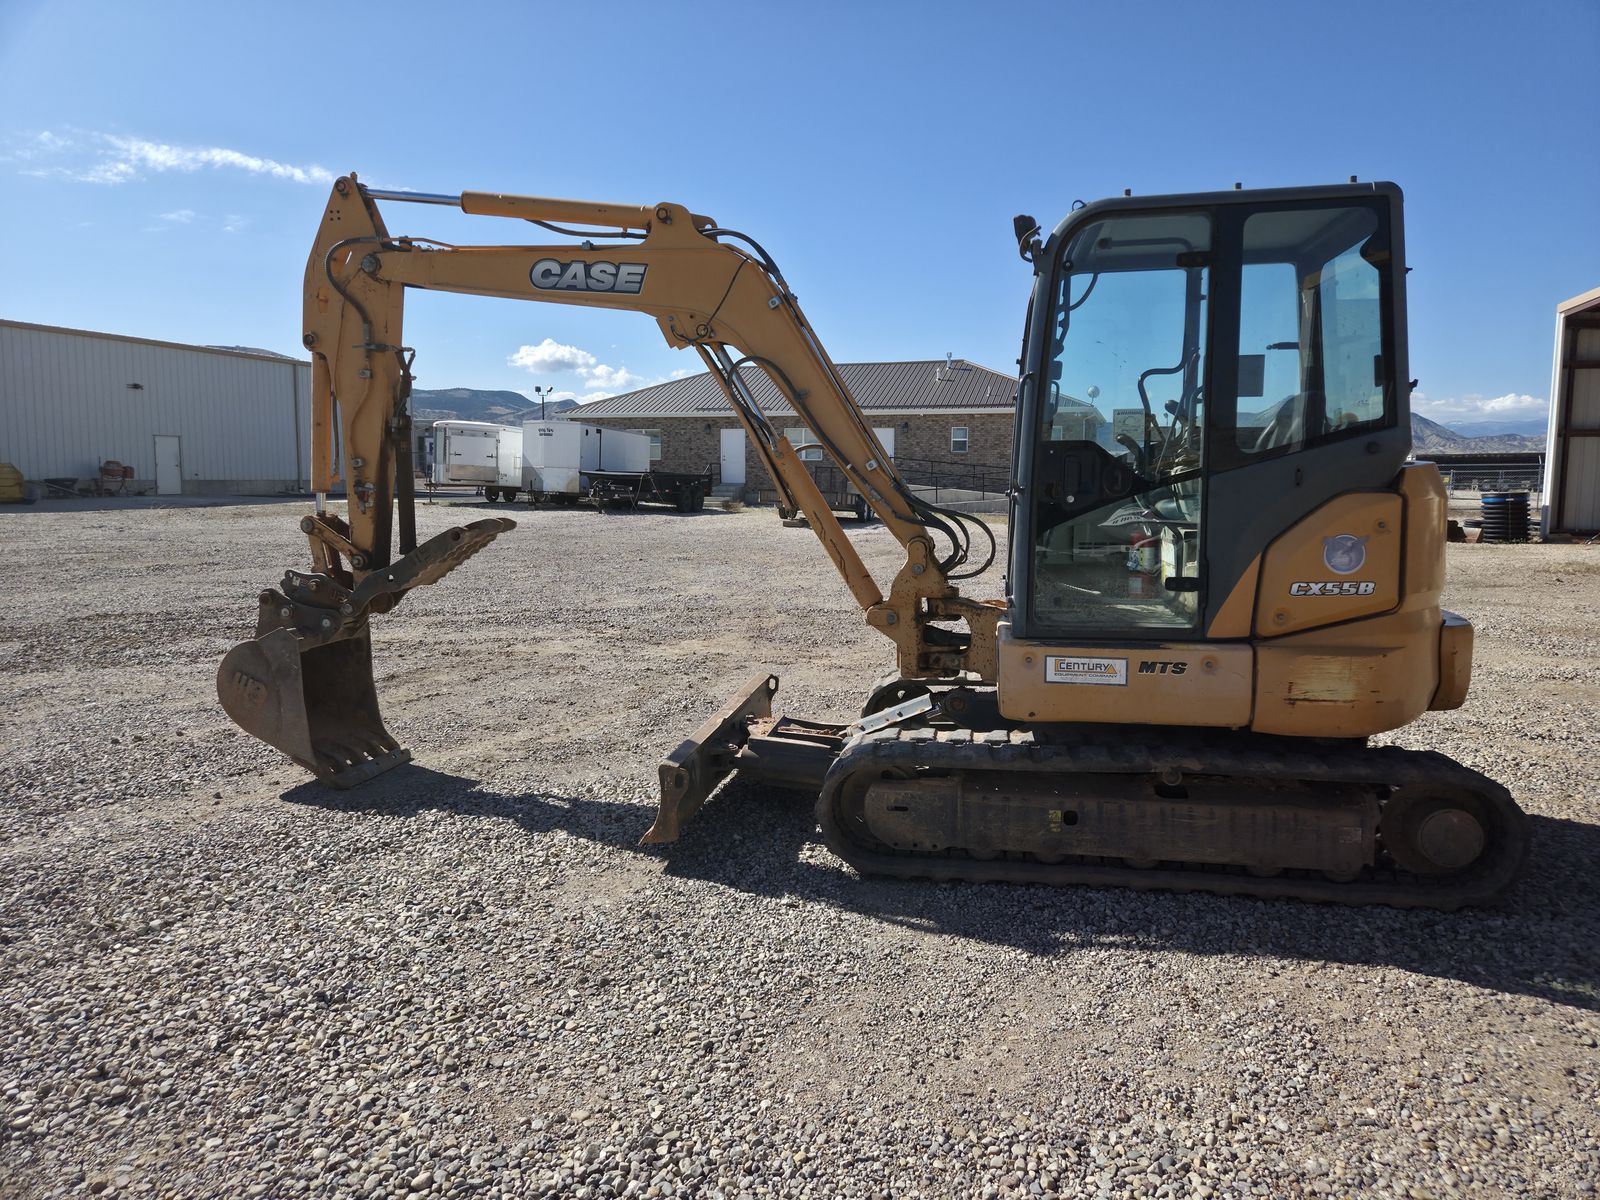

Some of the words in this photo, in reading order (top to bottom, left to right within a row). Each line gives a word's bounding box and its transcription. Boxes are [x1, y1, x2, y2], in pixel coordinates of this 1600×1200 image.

[530, 259, 647, 293] CASE
[1290, 581, 1375, 596] CX55B
[1059, 662, 1110, 672] CENTURY
[1138, 661, 1188, 675] MTS
